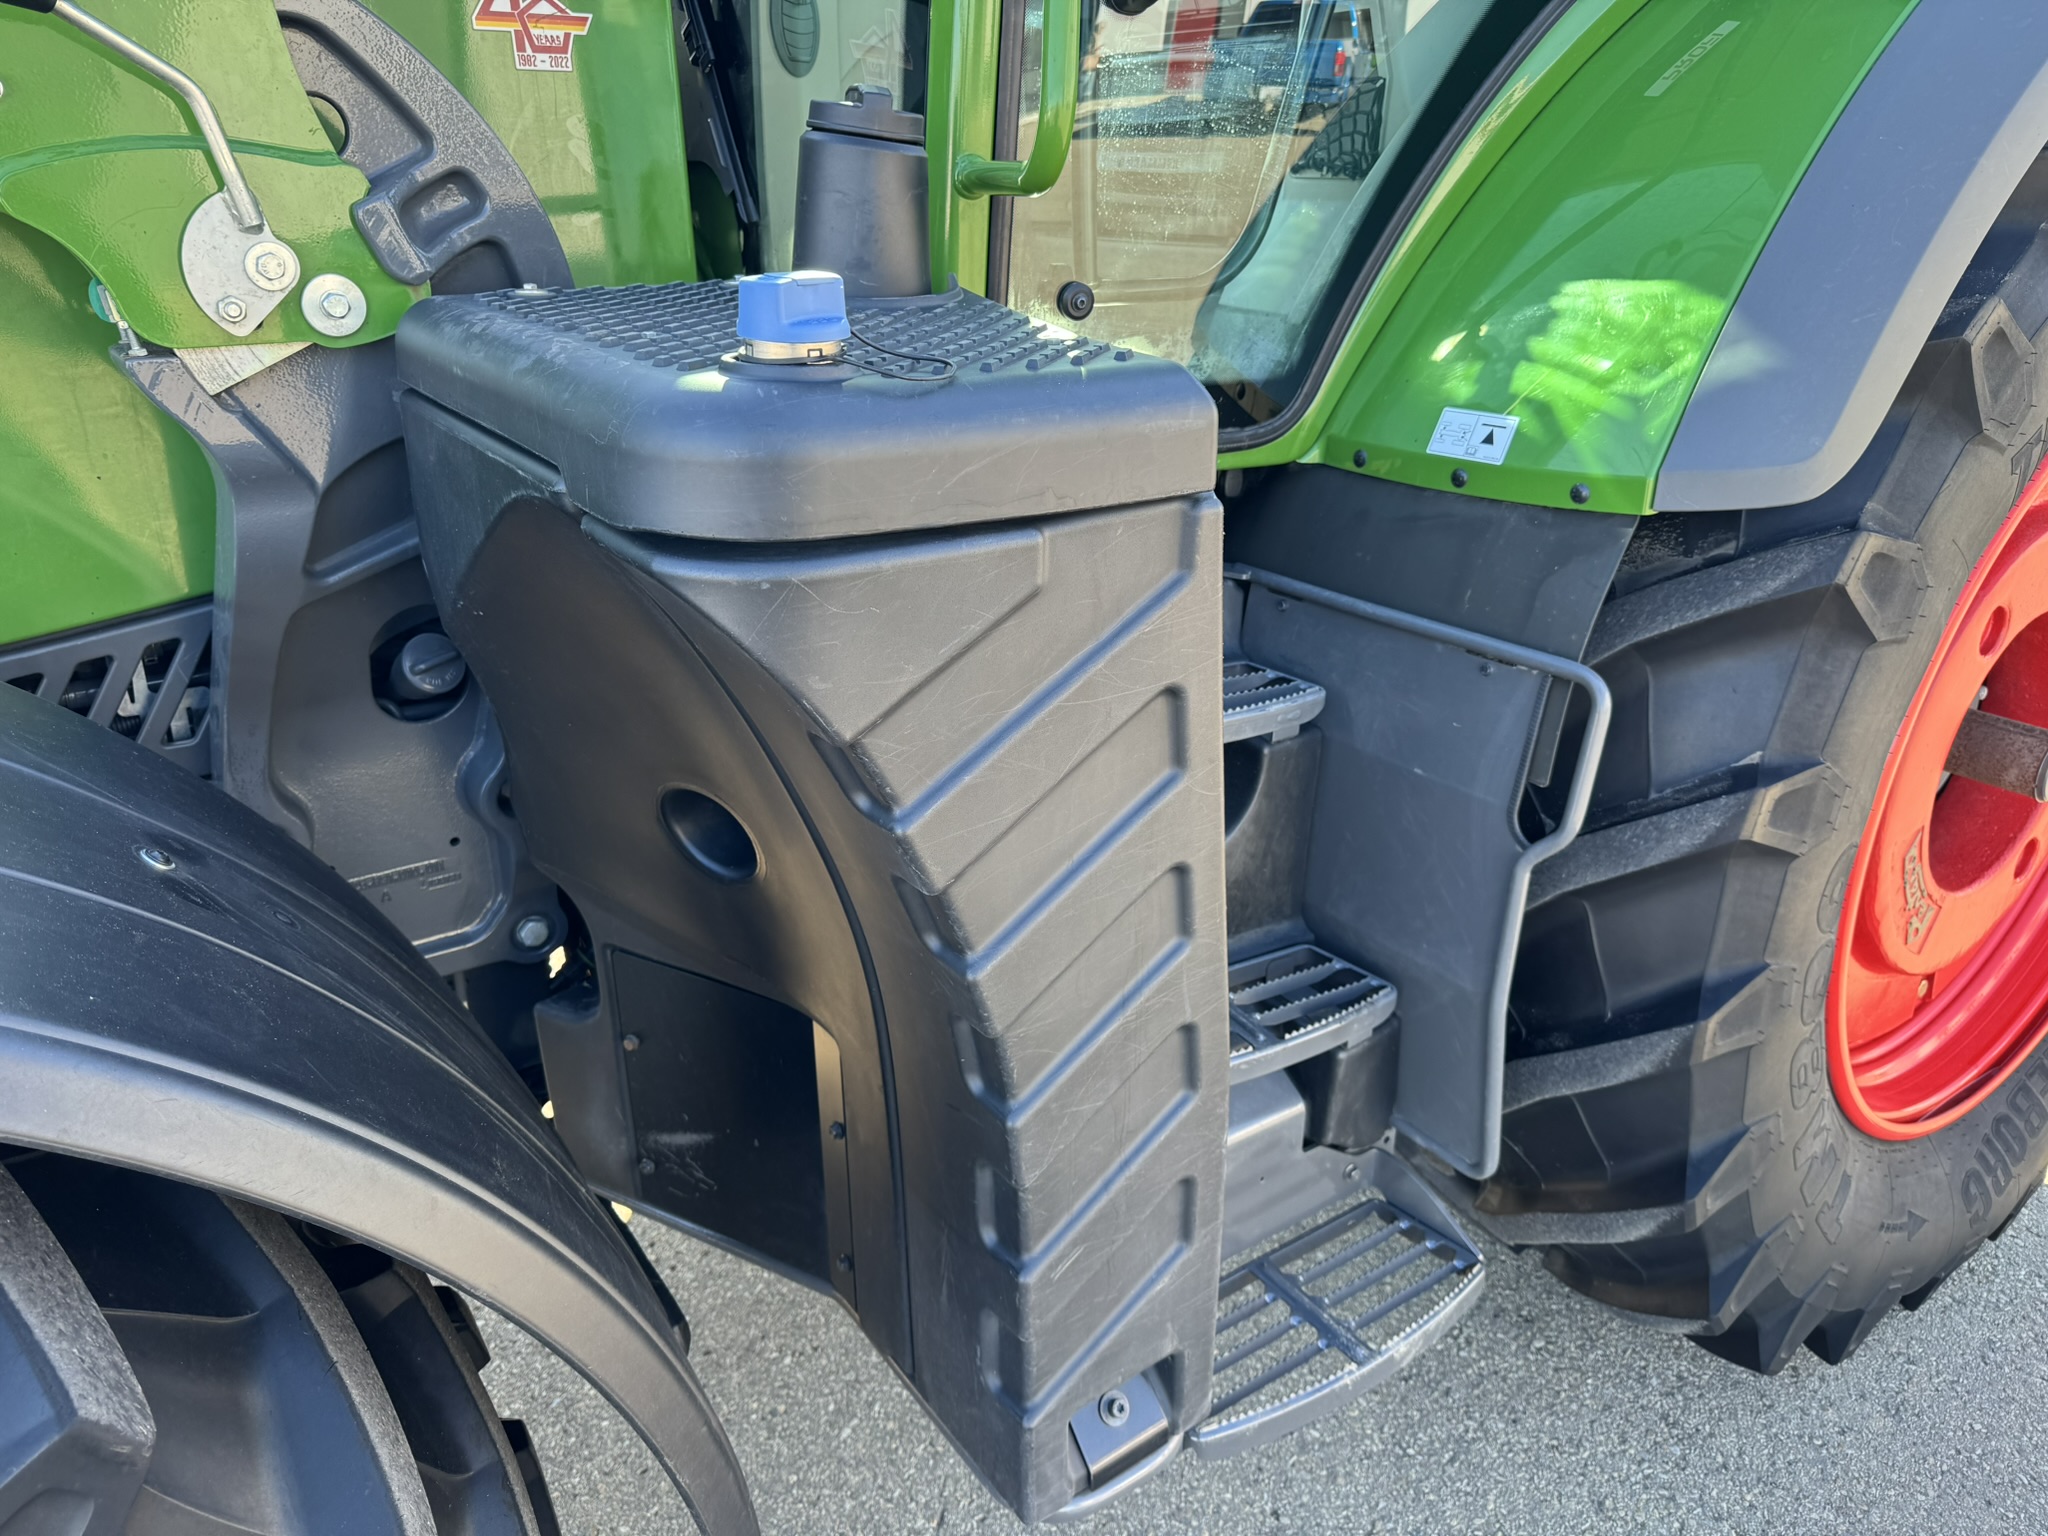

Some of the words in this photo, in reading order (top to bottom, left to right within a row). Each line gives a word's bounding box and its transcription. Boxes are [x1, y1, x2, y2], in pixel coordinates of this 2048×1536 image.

[533, 33, 562, 46] YEARS
[516, 54, 538, 67] 1982
[549, 55, 570, 69] 2022
